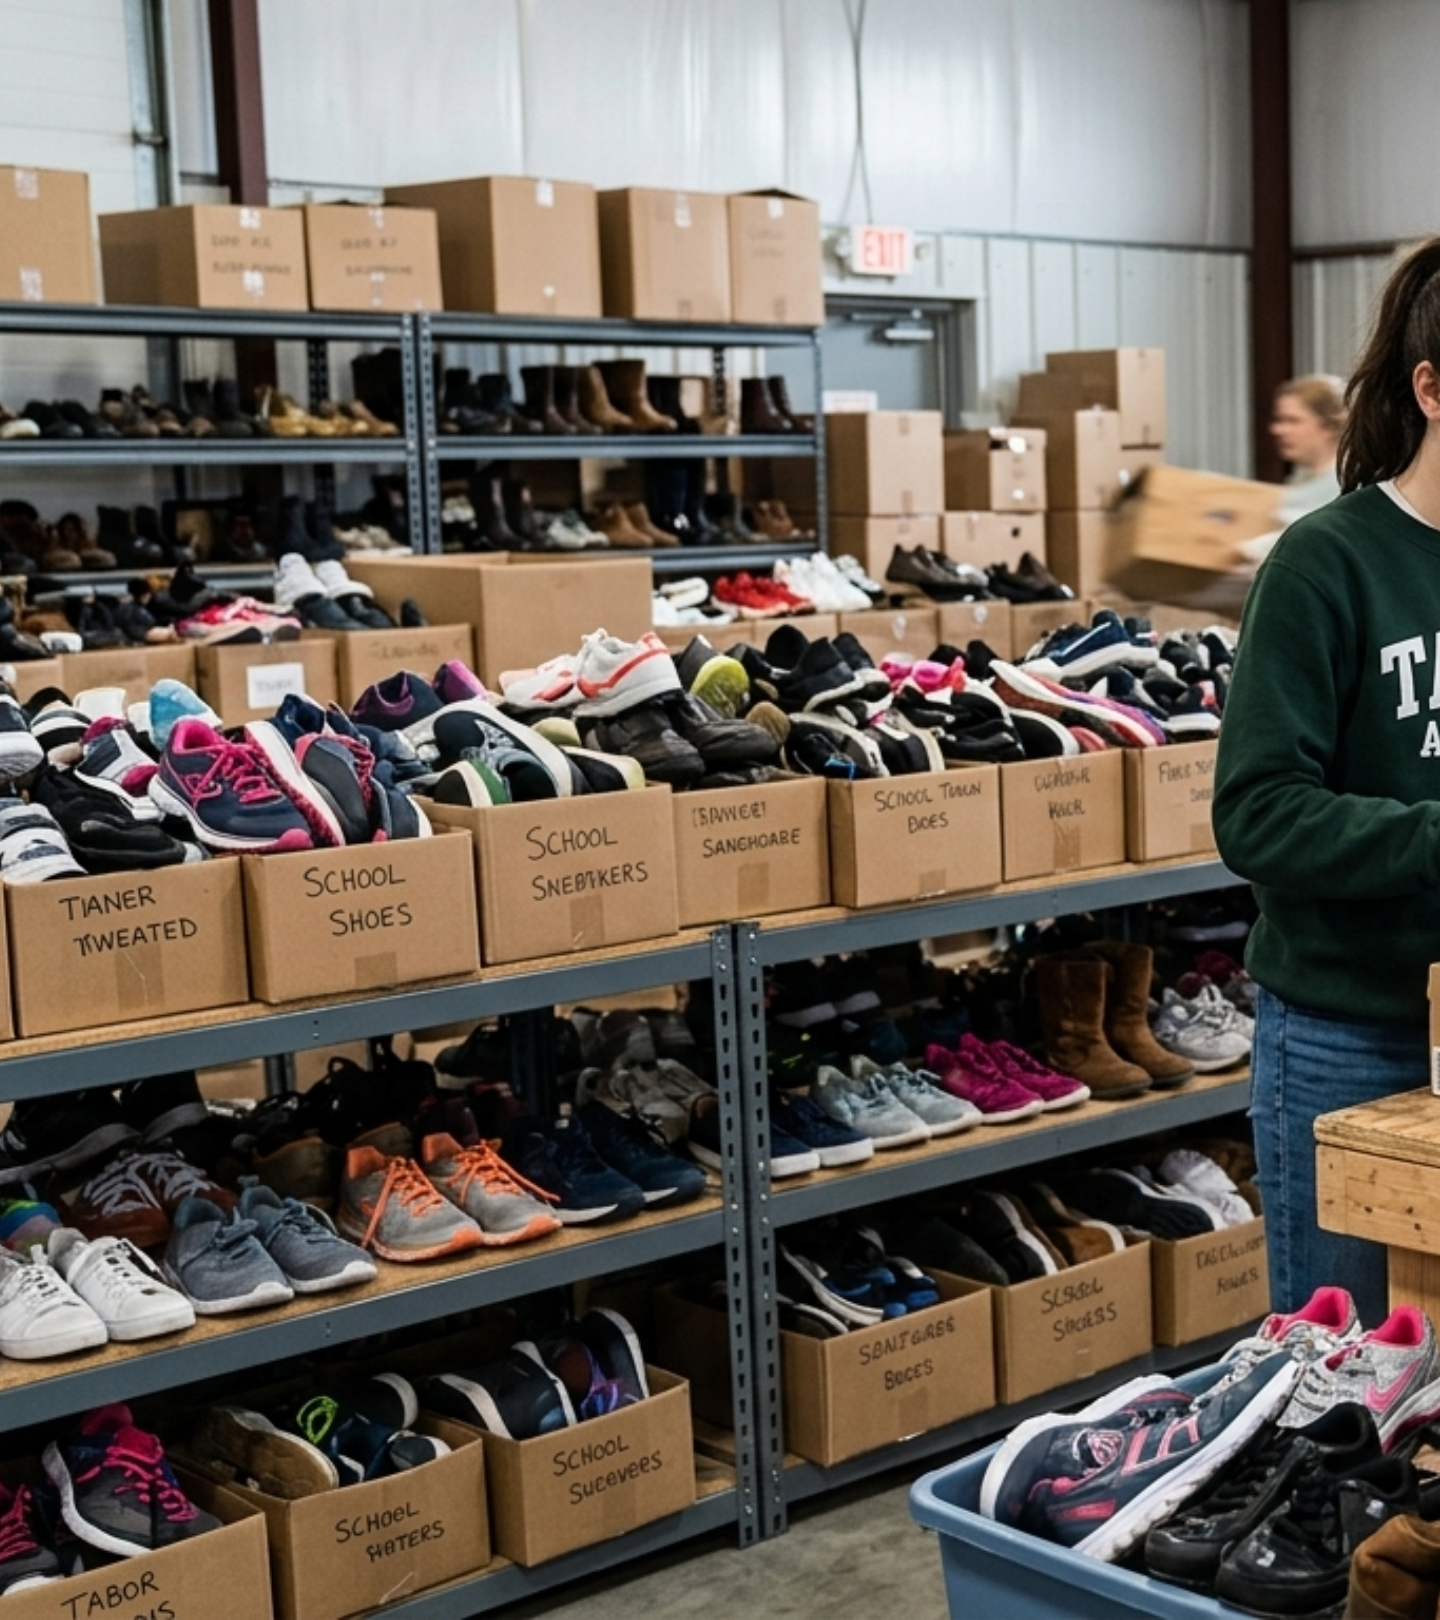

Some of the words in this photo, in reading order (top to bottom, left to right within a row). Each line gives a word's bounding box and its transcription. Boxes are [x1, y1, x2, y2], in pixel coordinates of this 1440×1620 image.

[526, 826, 618, 860] SCHOOL
[303, 864, 406, 897] SCHOOL
[58, 885, 156, 921] TIANER
[329, 902, 413, 936] SHOES
[553, 1434, 630, 1477] SCHOOL
[60, 1571, 159, 1620] TABOR
